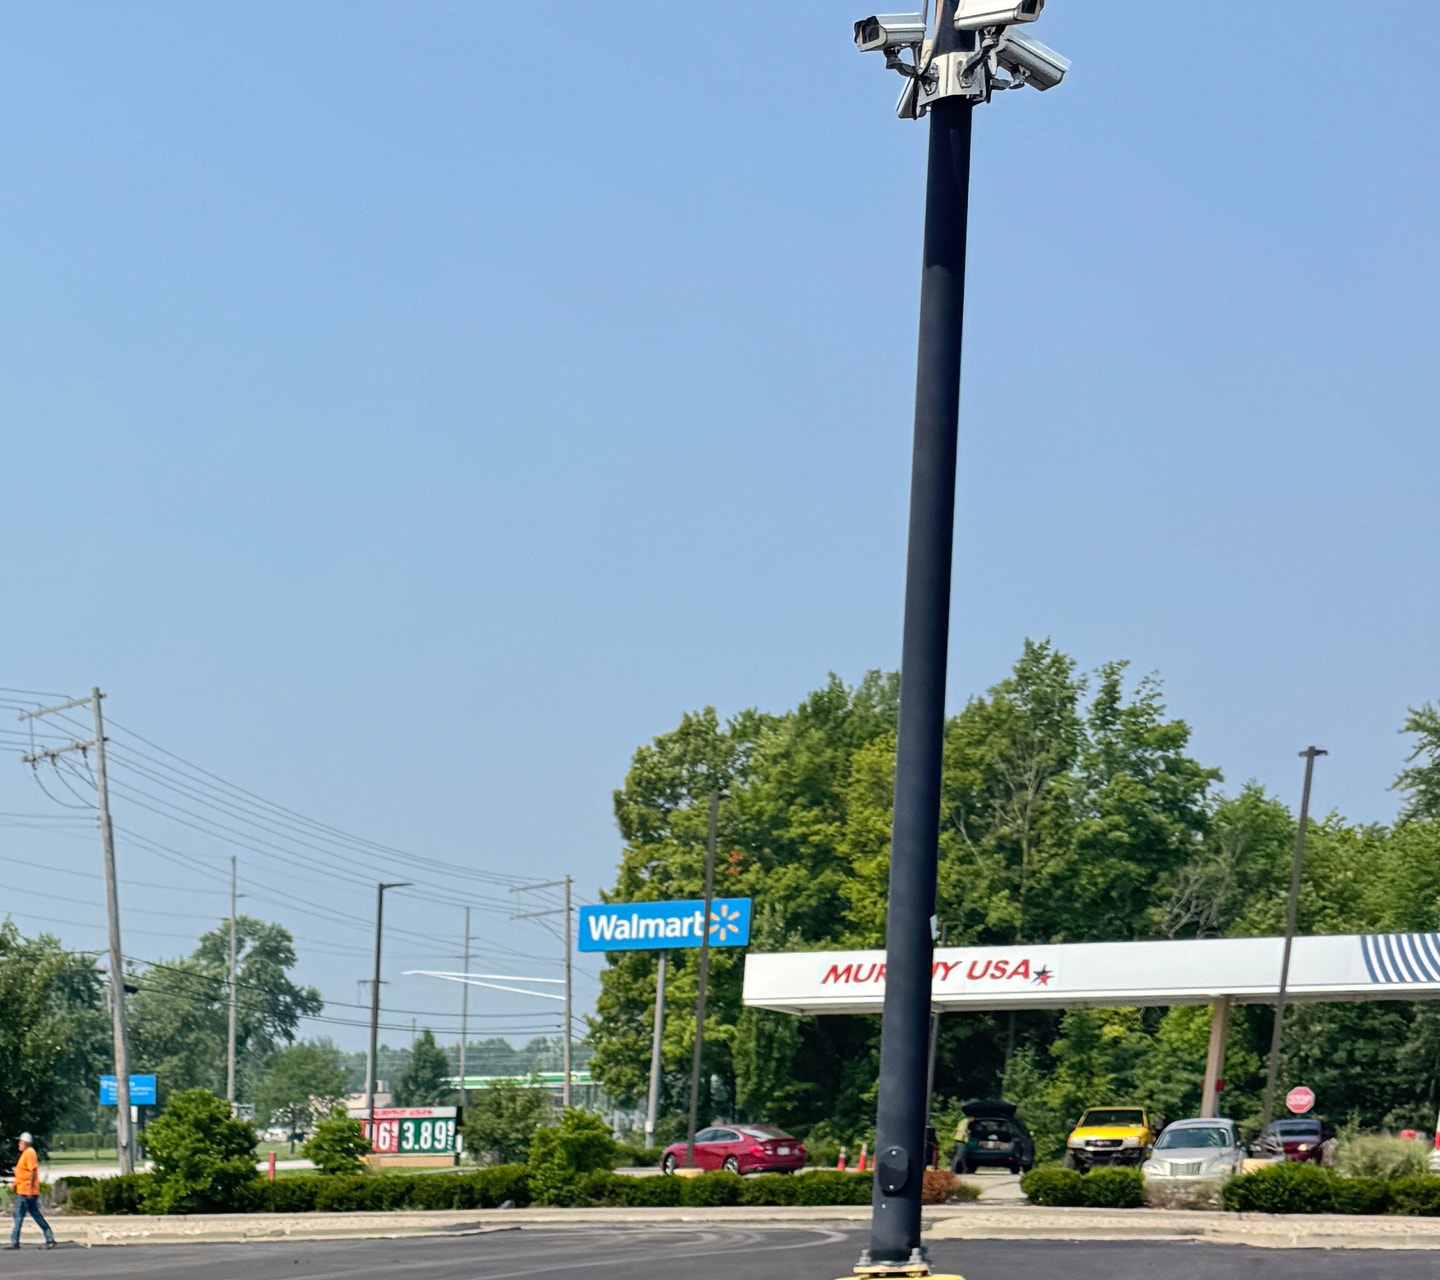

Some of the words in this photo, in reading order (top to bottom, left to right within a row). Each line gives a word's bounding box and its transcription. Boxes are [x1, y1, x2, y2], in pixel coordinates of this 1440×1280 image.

[588, 910, 706, 941] Walmart
[821, 961, 962, 984] MURY
[966, 959, 1031, 981] USA
[402, 1121, 446, 1150] 3.89
